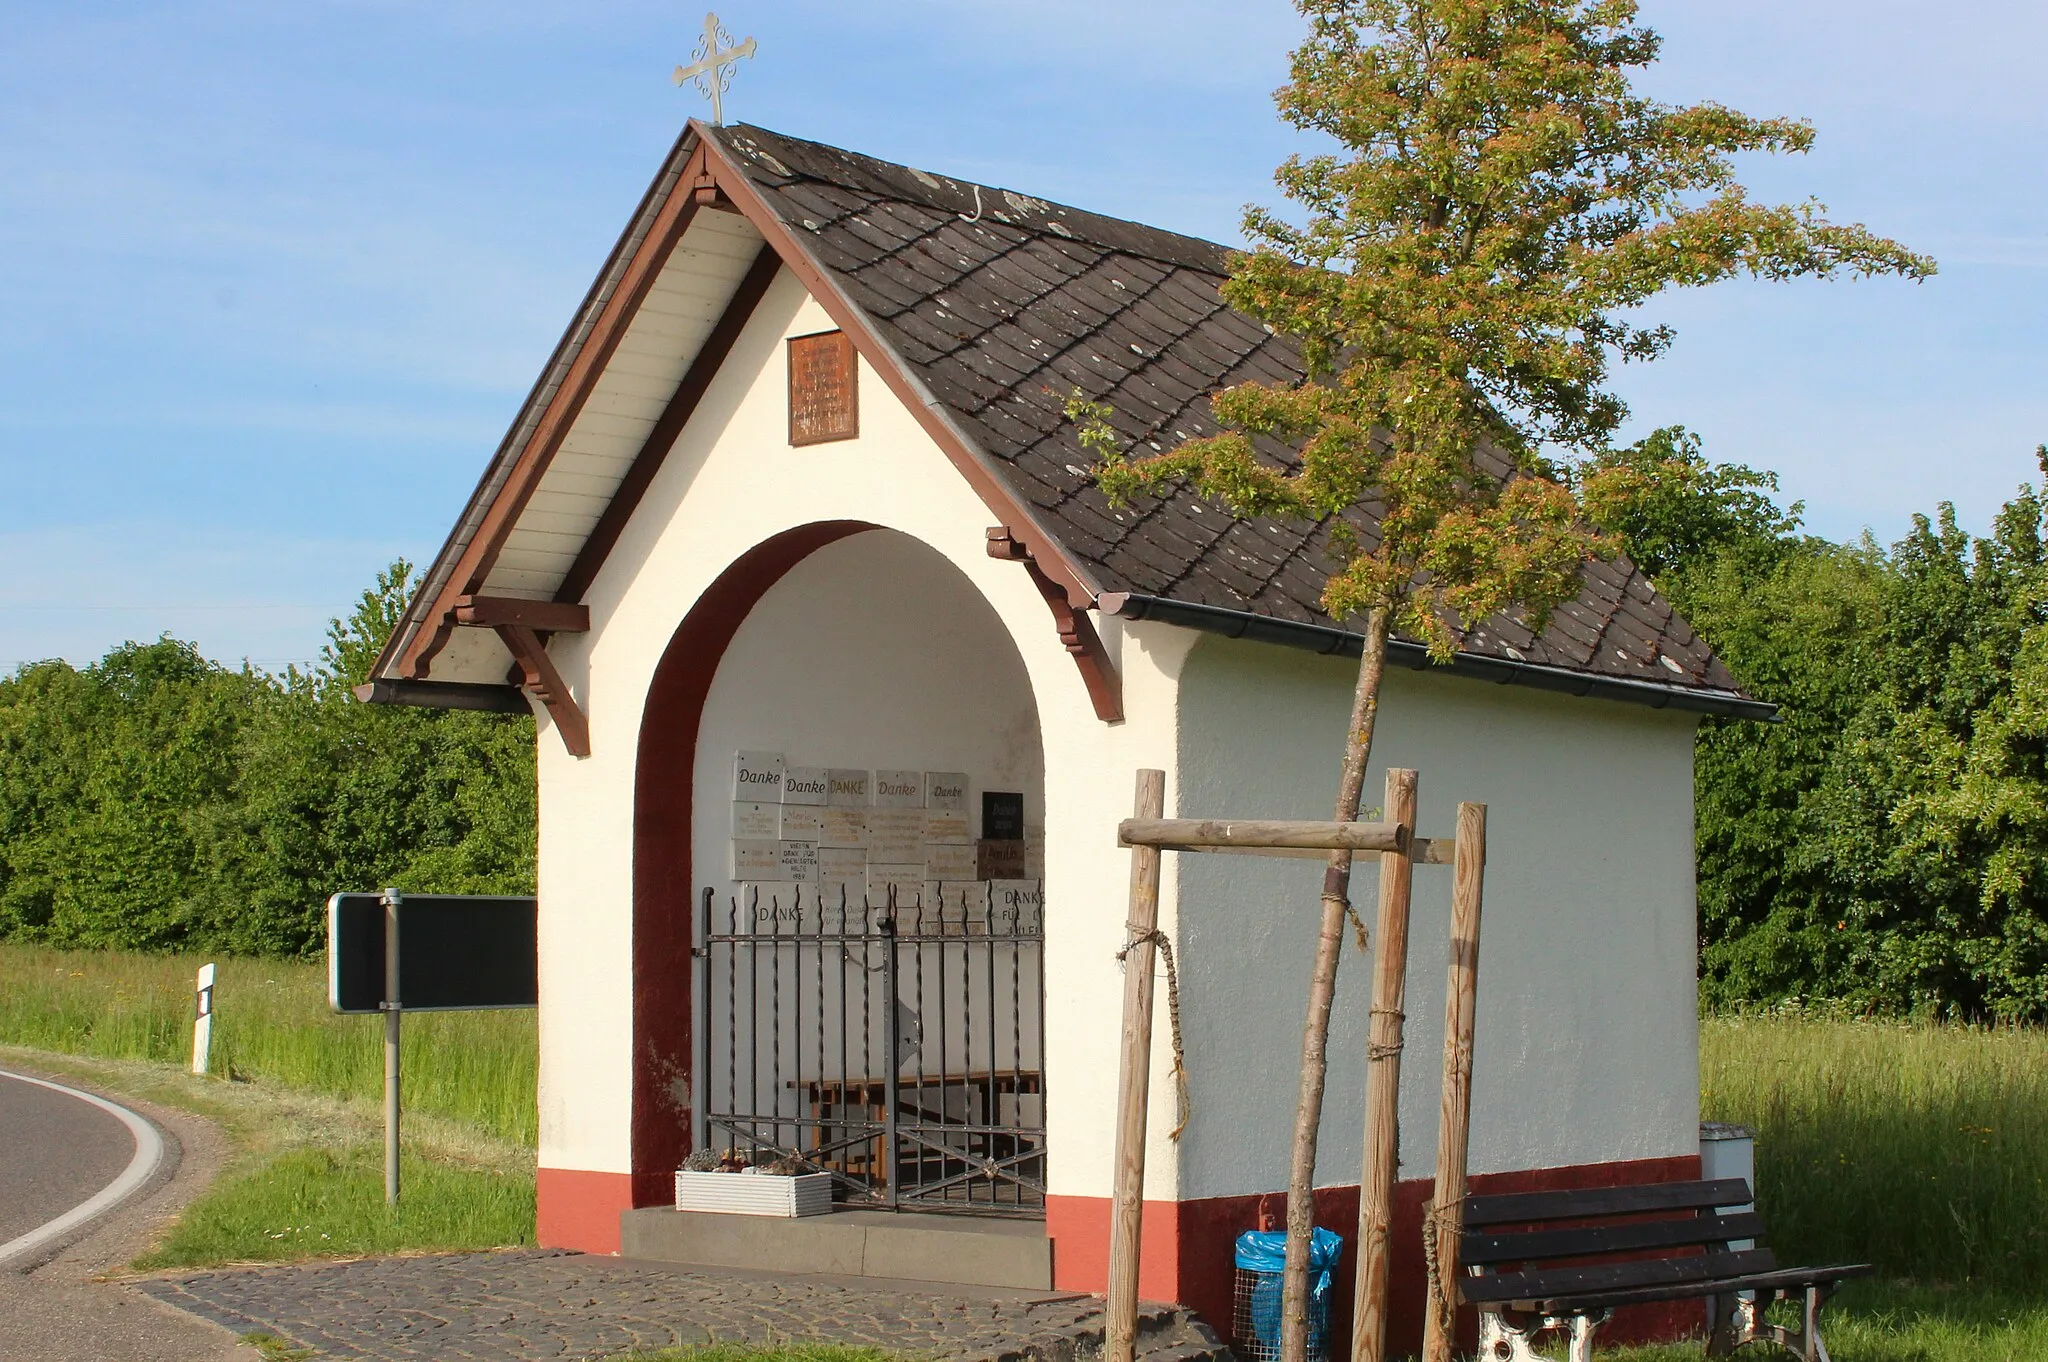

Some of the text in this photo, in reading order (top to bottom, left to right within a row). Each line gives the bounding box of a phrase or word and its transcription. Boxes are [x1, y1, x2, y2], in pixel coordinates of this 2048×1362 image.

[739, 769, 781, 785] Danke
[786, 778, 826, 794] Danke
[830, 780, 865, 795] DANKE
[878, 781, 917, 797] Danke
[933, 786, 963, 798] Danke
